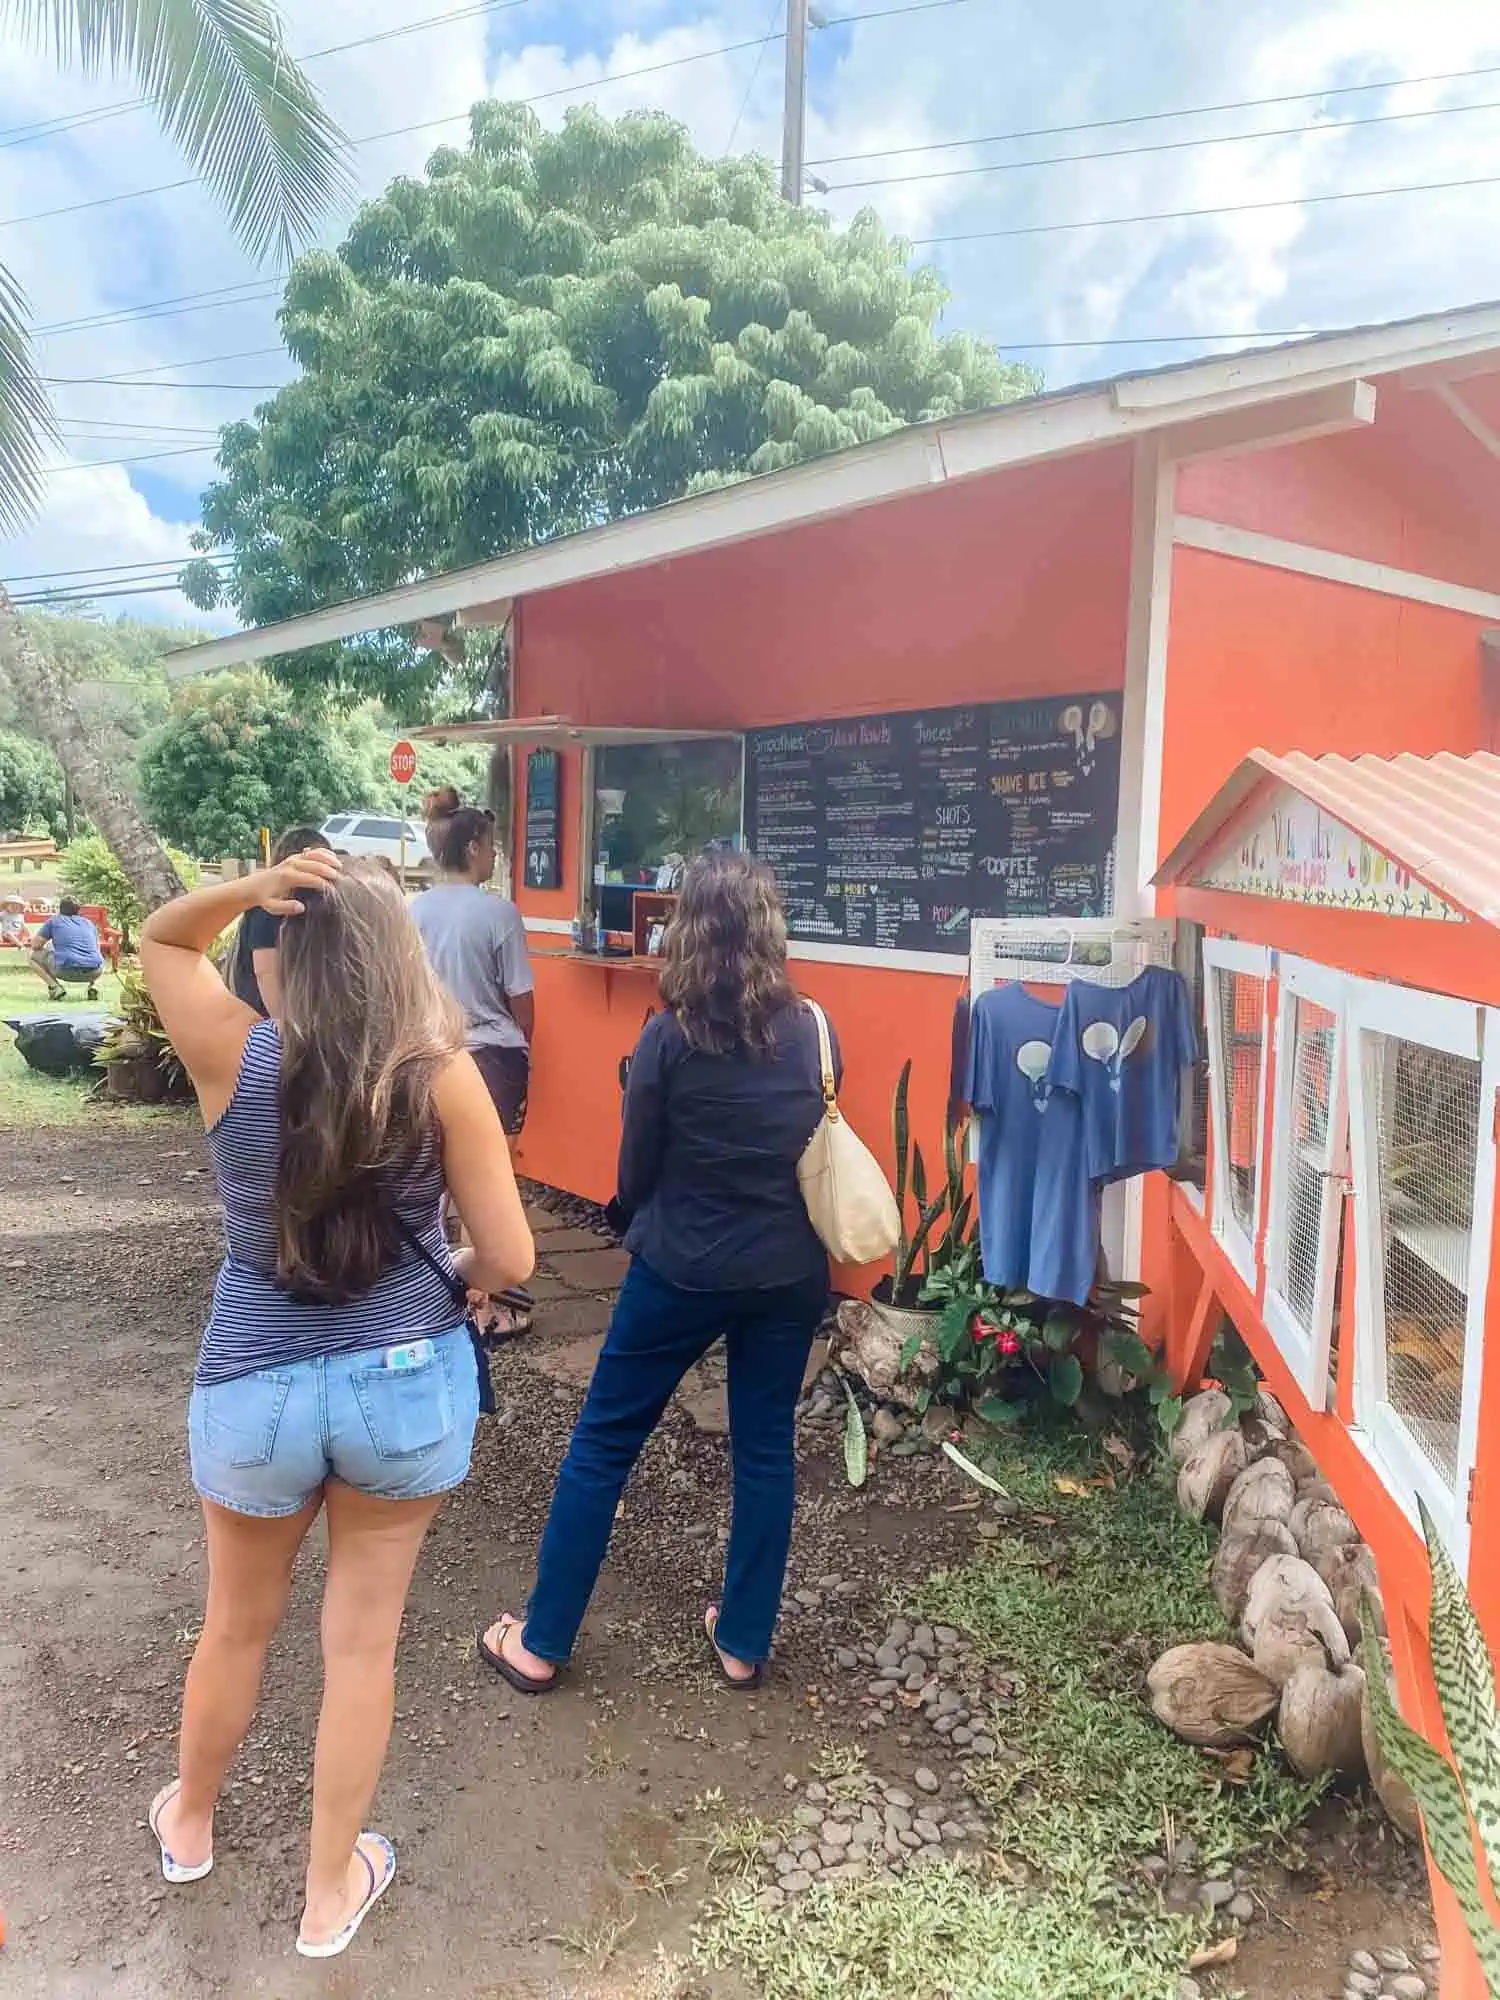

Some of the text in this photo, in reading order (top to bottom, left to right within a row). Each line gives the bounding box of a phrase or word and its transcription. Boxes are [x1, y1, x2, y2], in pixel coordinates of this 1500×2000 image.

[391, 754, 416, 770] STOP
[1028, 771, 1048, 793] ICE
[935, 804, 971, 825] SHOTS
[983, 856, 1039, 876] COFFEE
[844, 883, 867, 896] MORE
[24, 903, 59, 914] ALOH
